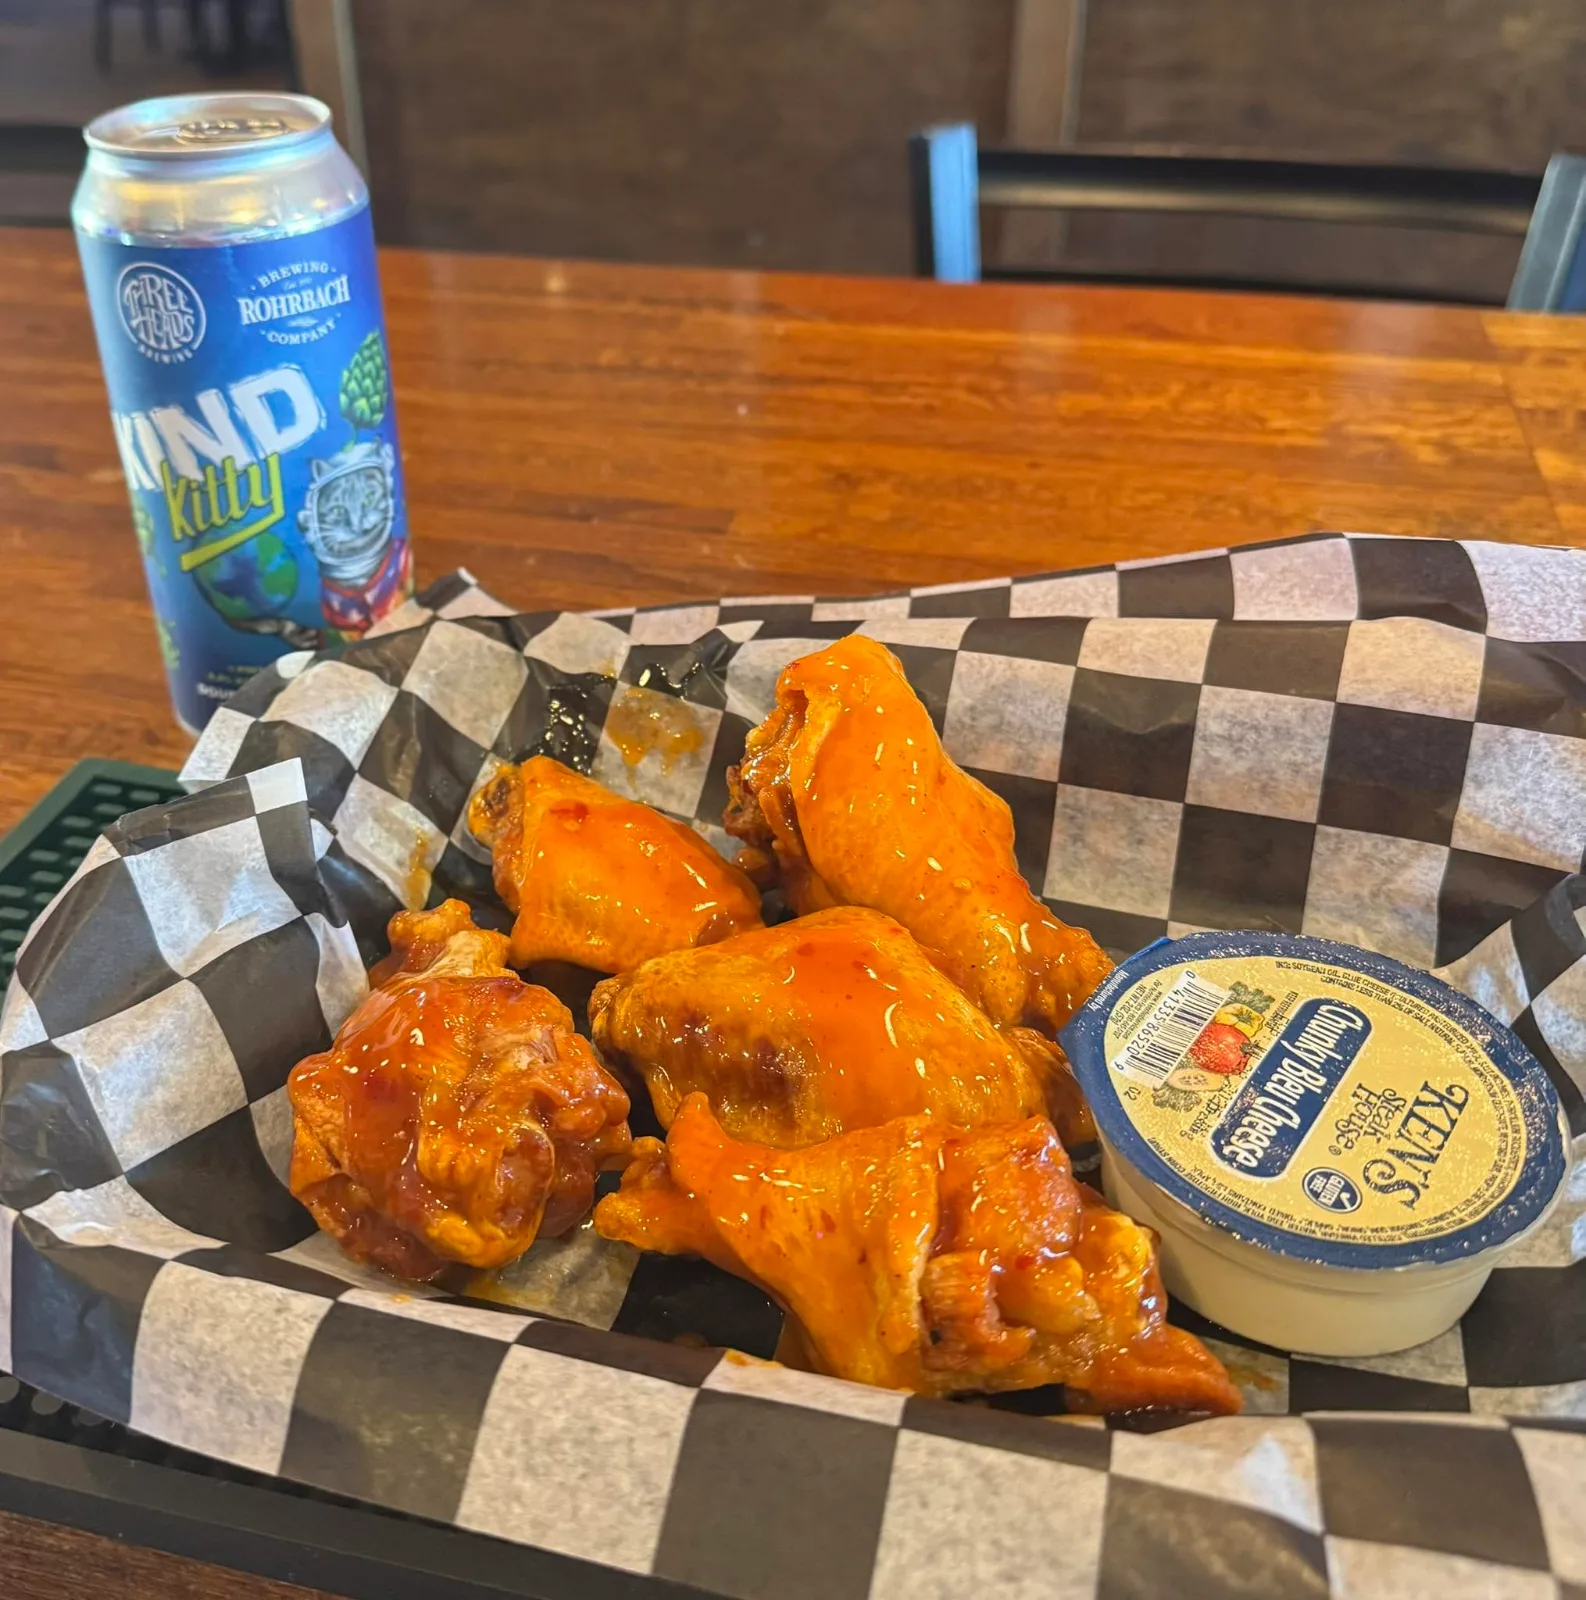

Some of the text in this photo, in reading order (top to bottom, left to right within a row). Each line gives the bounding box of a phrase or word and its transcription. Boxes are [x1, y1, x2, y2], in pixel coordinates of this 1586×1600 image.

[257, 259, 329, 288] BREWING
[238, 273, 351, 326] ROHRBACH
[266, 318, 335, 345] COMPANY
[112, 363, 326, 492] KIND
[160, 452, 286, 572] kitty
[1093, 969, 1130, 1005] Manufactured
[1134, 983, 1147, 996] NET
[1086, 1002, 1101, 1011] by
[1110, 969, 1196, 1071] 0 41335 86520 9
[1221, 1003, 1360, 1167] Chunky Bleu Cheese
[1364, 1081, 1471, 1210] KEN'S
[1308, 1173, 1327, 1192] FREE
[1316, 1174, 1345, 1205] GLUTEN
